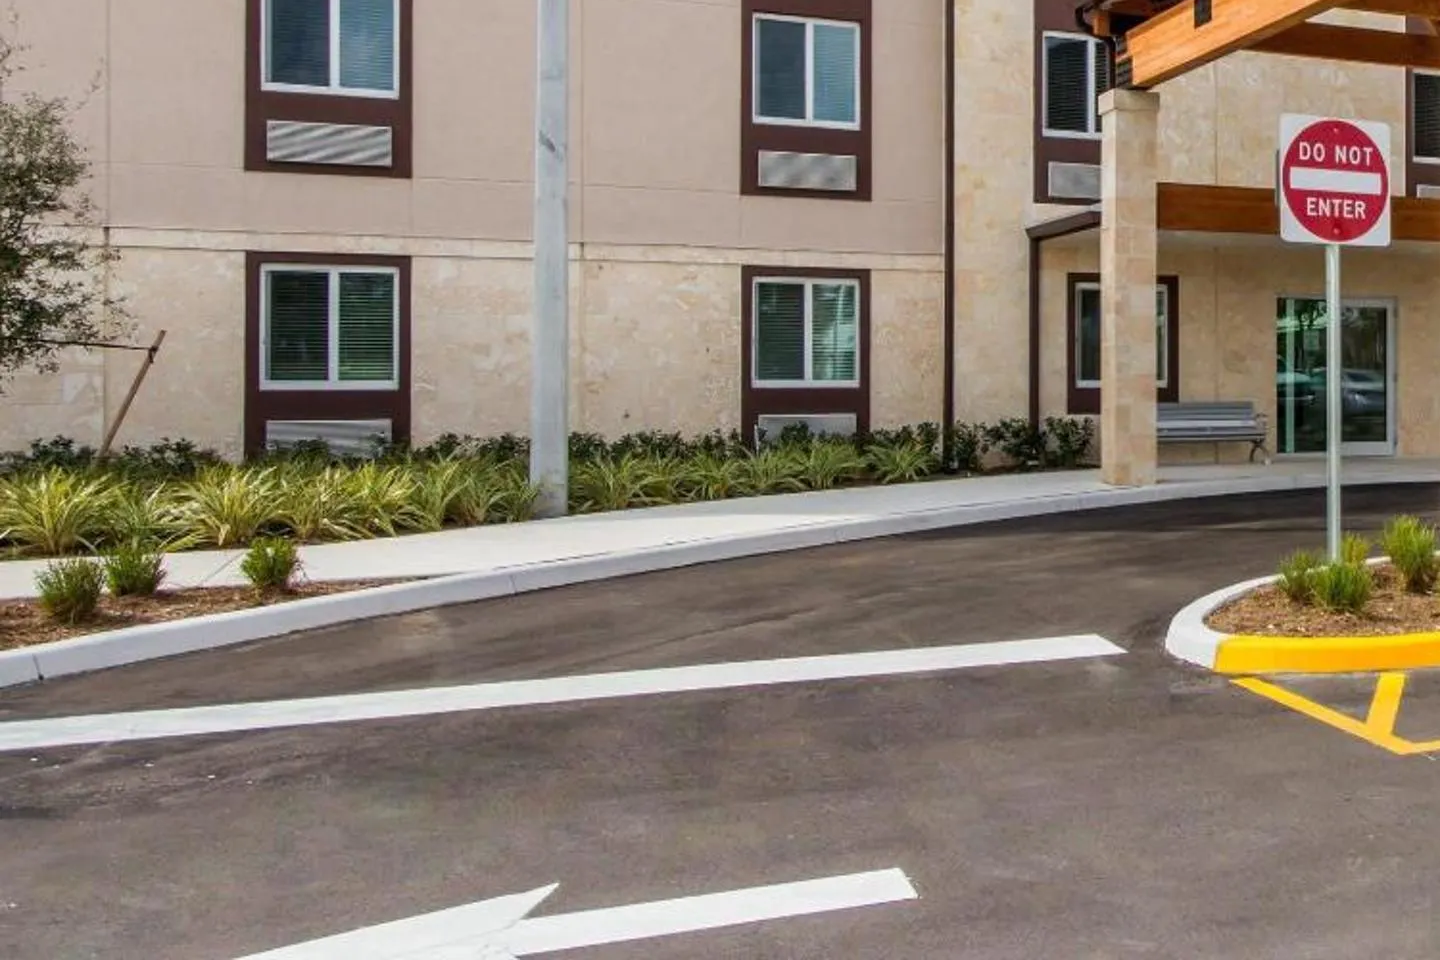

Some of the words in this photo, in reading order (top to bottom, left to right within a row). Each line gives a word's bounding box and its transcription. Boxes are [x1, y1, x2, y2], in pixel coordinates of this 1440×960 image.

[1299, 141, 1325, 162] DO
[1335, 145, 1373, 166] NOT
[1306, 197, 1366, 219] ENTER
